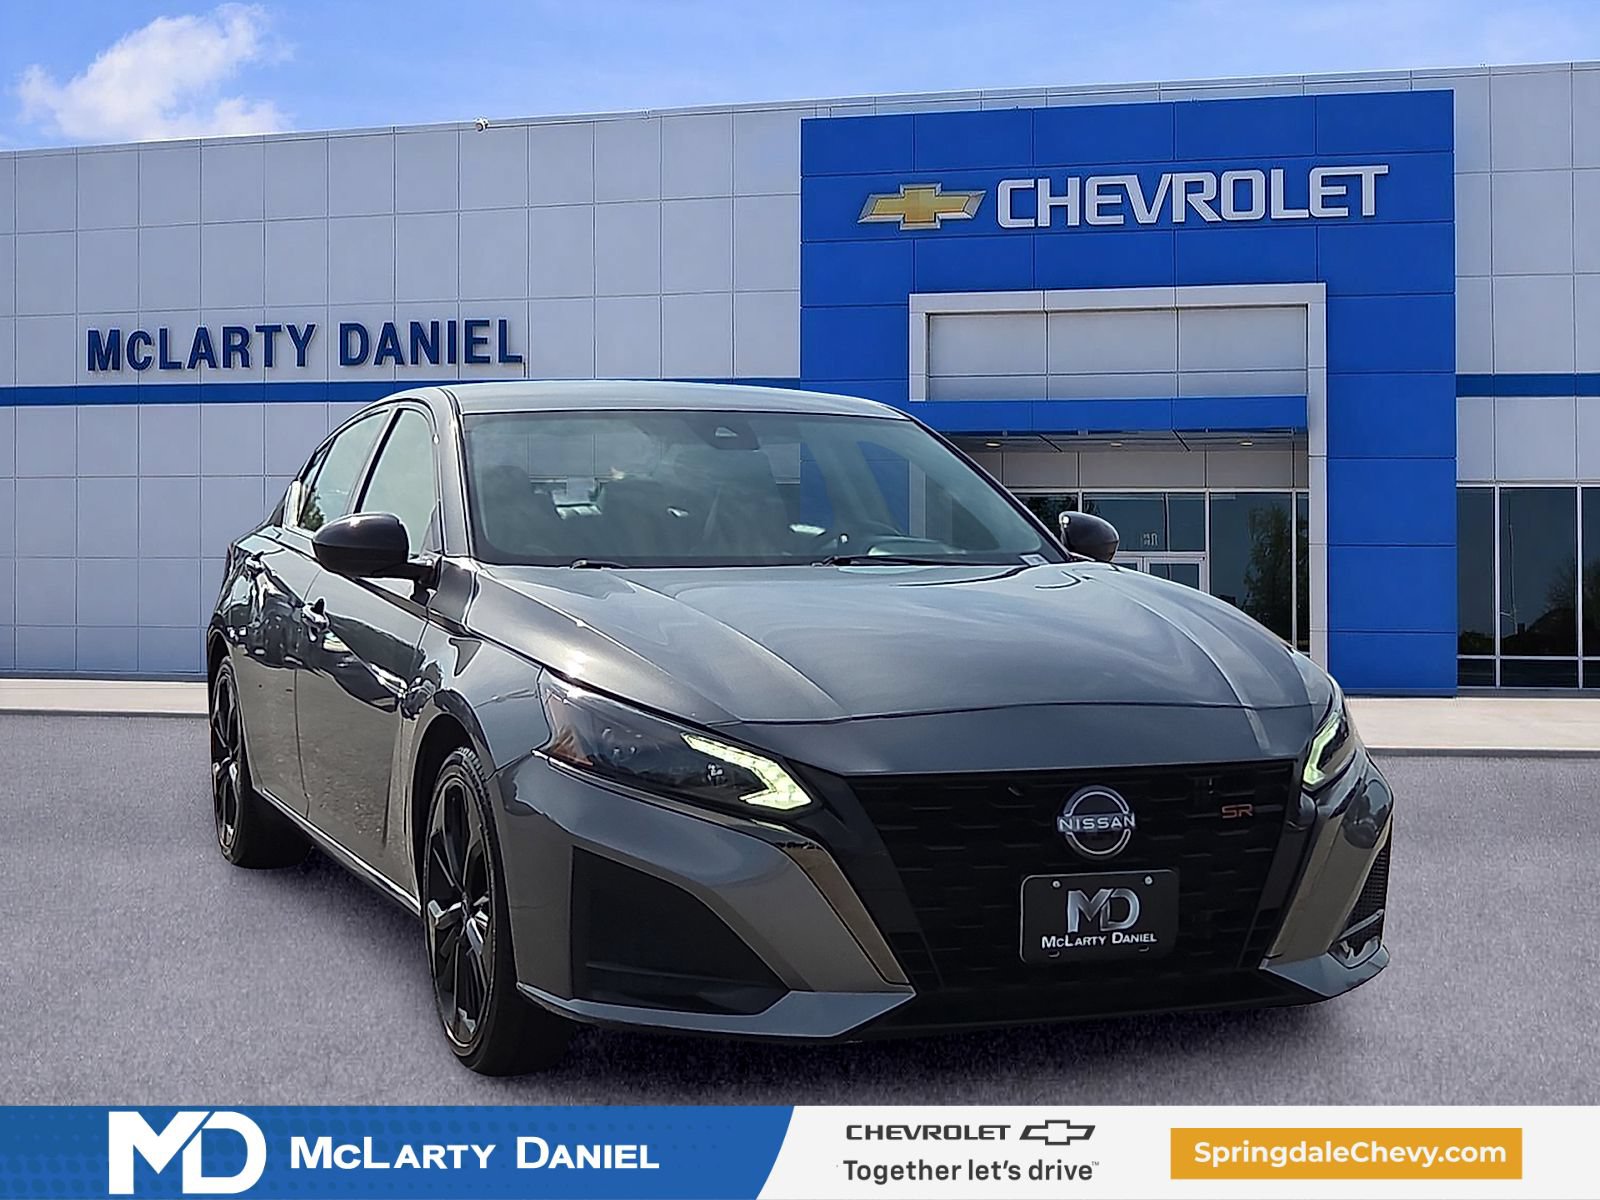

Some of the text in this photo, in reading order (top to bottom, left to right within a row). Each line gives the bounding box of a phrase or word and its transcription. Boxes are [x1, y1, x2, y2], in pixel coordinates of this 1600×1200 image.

[996, 164, 1390, 229] CHEVROLET
[339, 318, 523, 367] DANIEL
[1057, 814, 1136, 833] NISSAN
[1221, 804, 1254, 819] SR
[1066, 887, 1140, 933] MD
